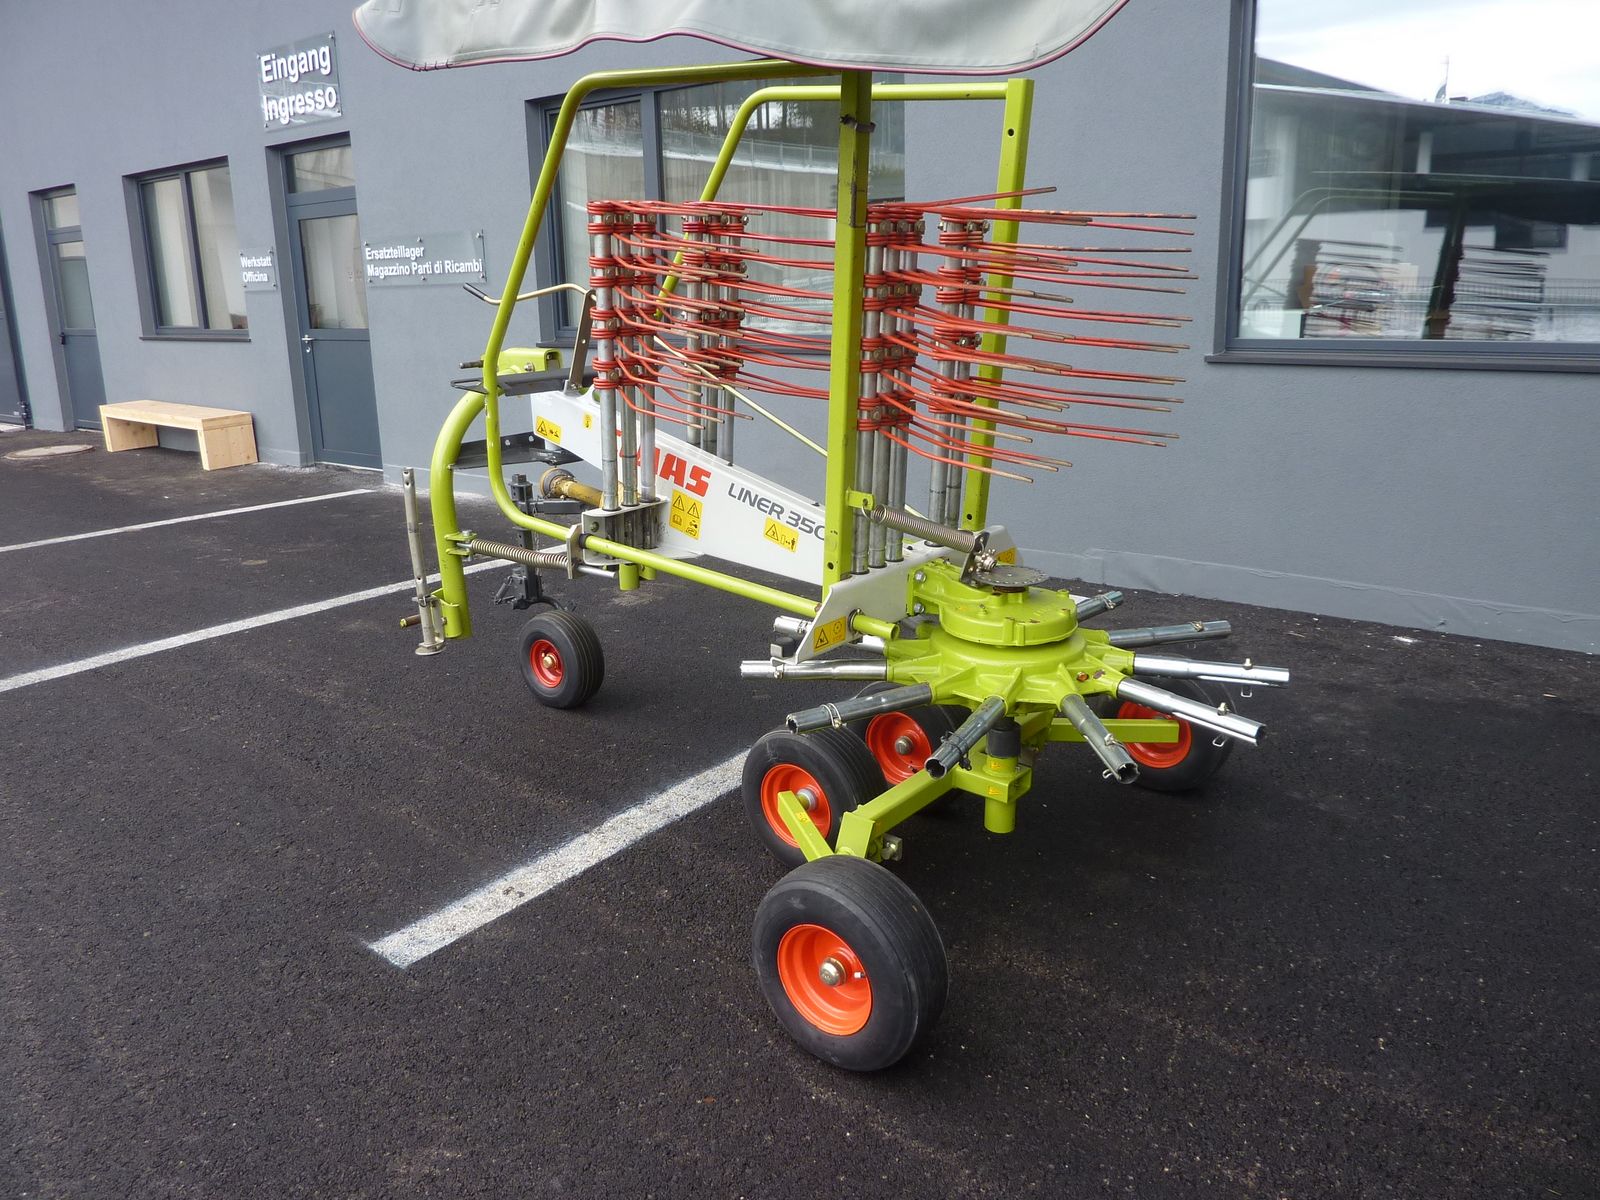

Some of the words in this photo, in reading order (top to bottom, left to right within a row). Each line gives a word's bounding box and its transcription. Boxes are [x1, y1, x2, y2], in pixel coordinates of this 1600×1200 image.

[260, 46, 331, 82] Eingang
[262, 87, 337, 124] Ingresso
[240, 256, 272, 268] Werkstatt
[365, 246, 424, 260] Ersatzteillager
[243, 271, 268, 282] Officina
[367, 263, 410, 279] Magazzino
[411, 261, 432, 274] Parti
[434, 260, 443, 273] di
[444, 258, 483, 273] Ricambi
[728, 482, 785, 520] LINER
